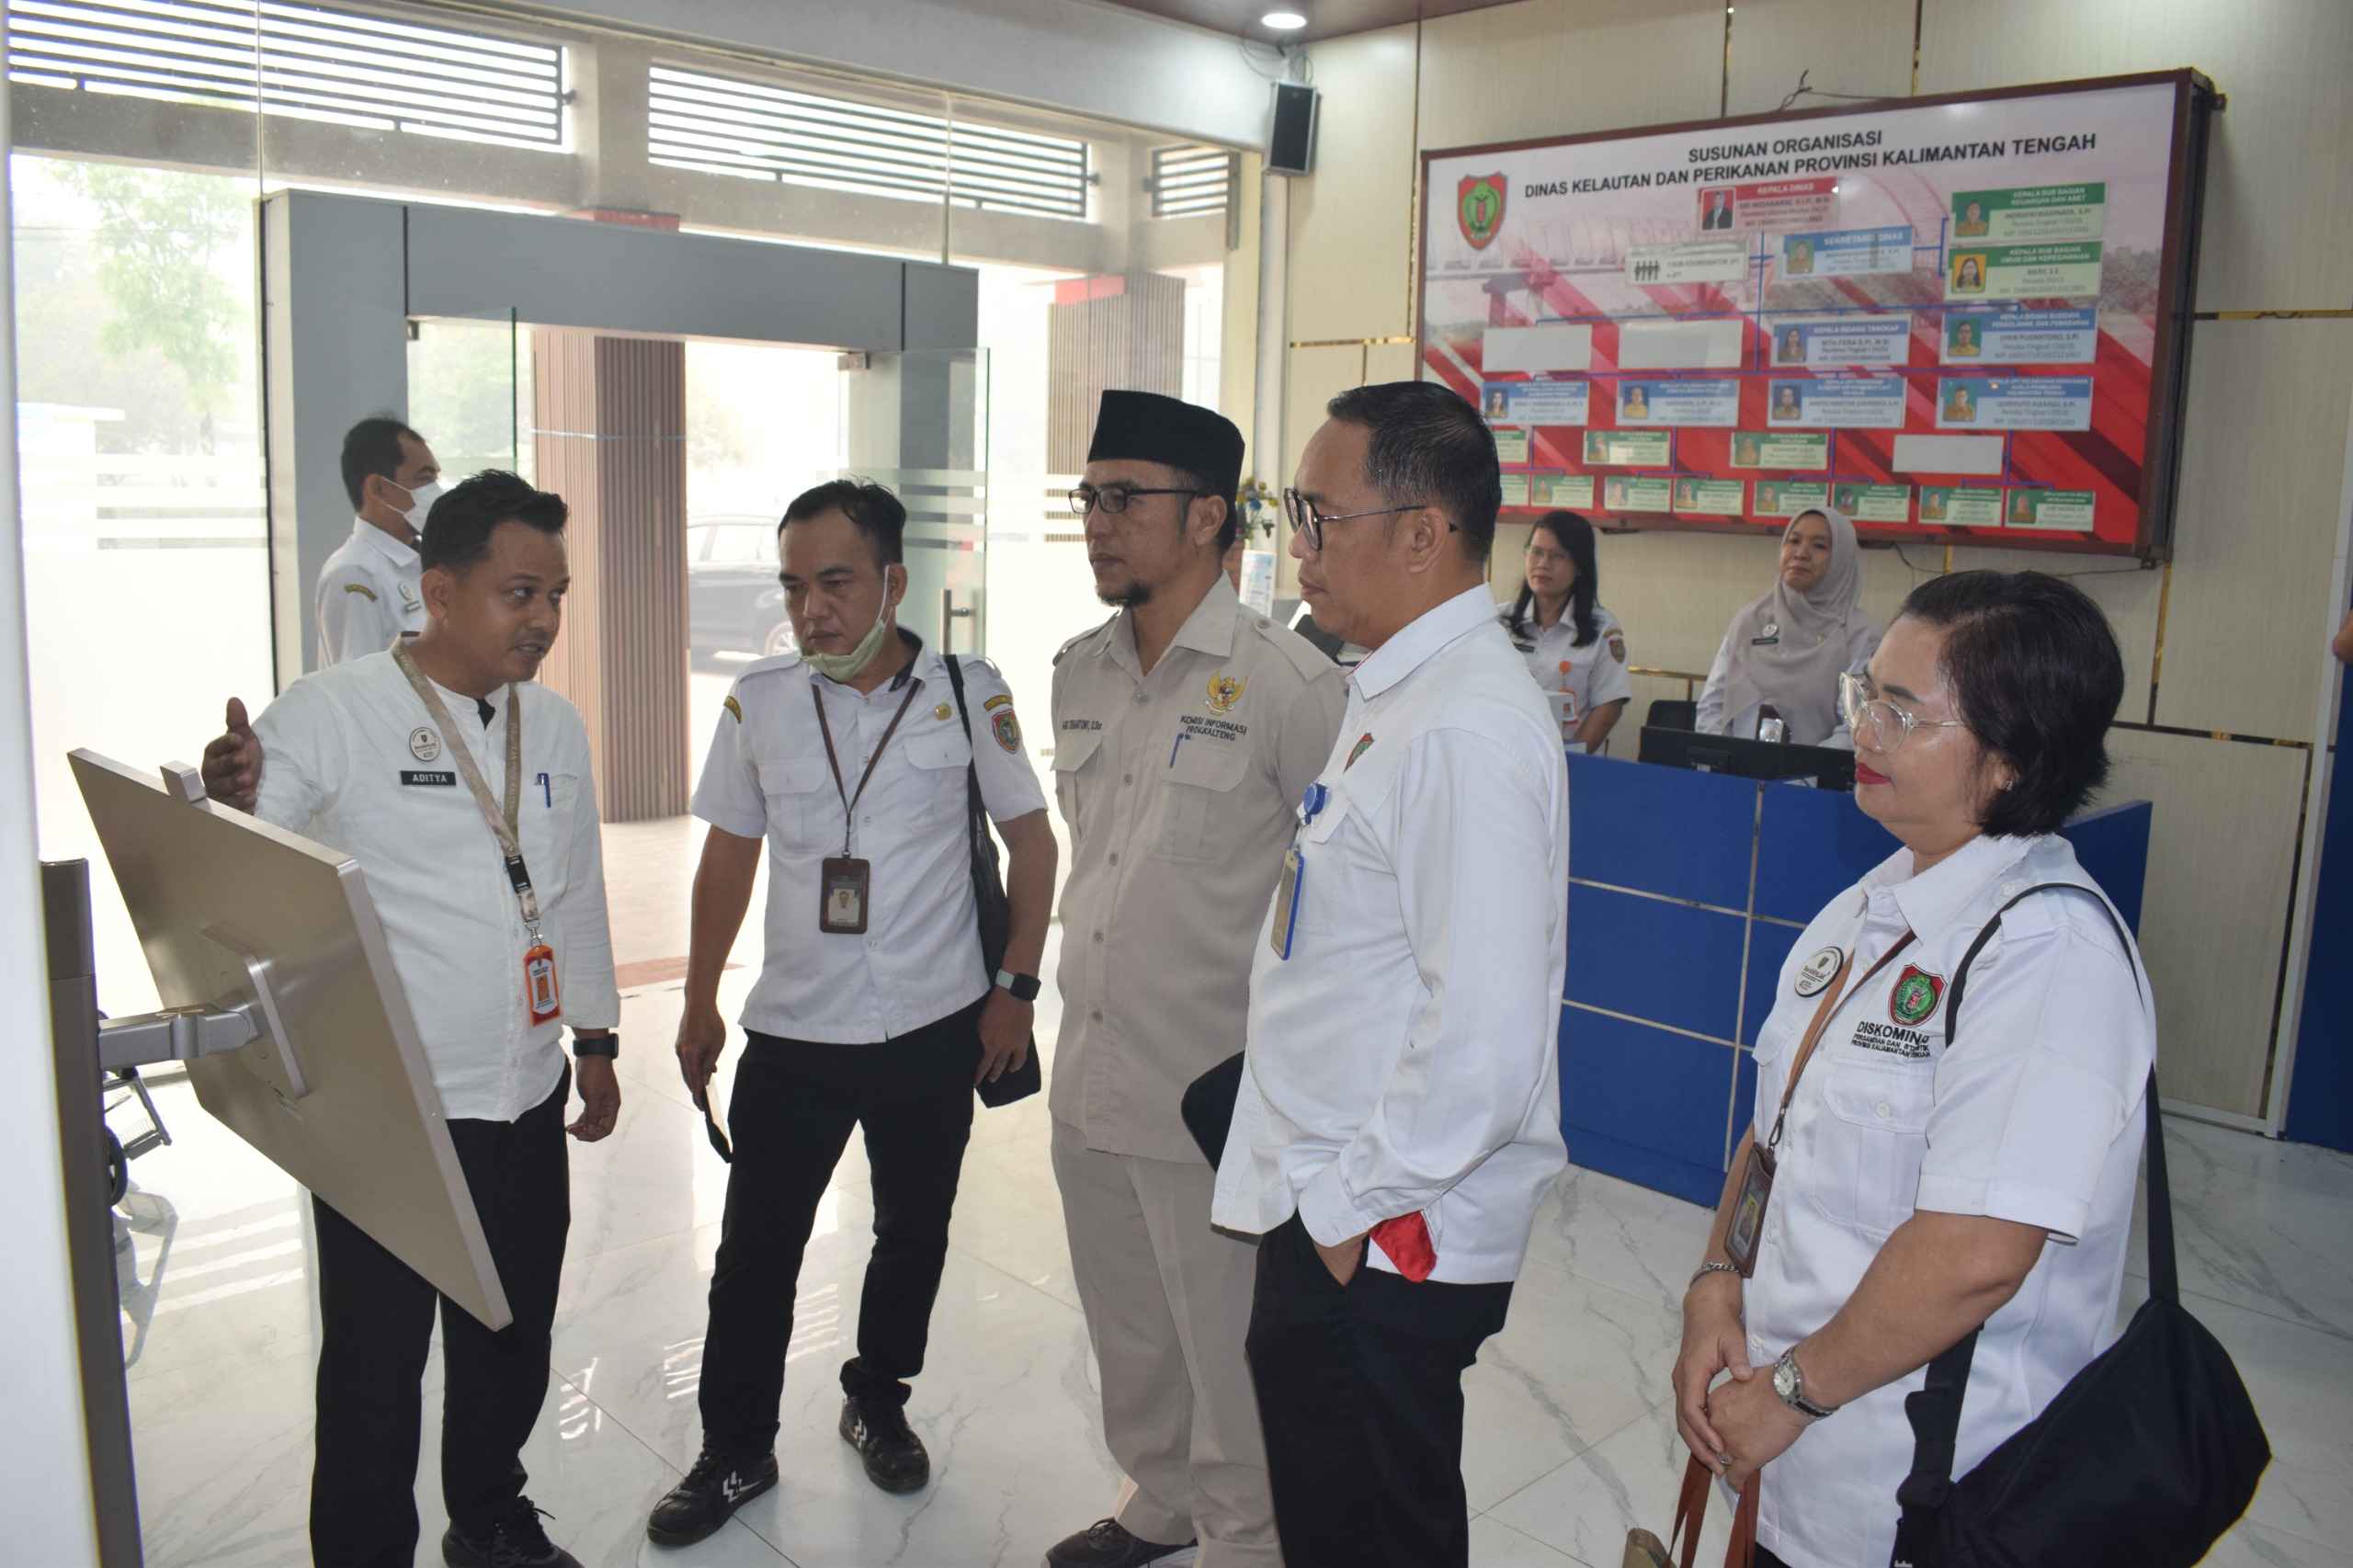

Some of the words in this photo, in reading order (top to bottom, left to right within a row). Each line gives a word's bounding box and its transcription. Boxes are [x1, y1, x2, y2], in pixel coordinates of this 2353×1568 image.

[1688, 142, 1768, 163] SUSUNAN
[1773, 130, 1882, 154] ORGANISASI
[1525, 182, 1568, 198] DINAS
[1572, 174, 1650, 194] KELAUTAN
[1655, 170, 1688, 186] DAN
[1693, 163, 1790, 183] PERIKANAN
[1794, 150, 1877, 173] PROVINSI
[1882, 141, 2005, 166] KALIMANTAN
[2012, 133, 2096, 155] TENGAH
[1204, 719, 1248, 735] INFORMASI
[412, 774, 448, 782] ADITYA
